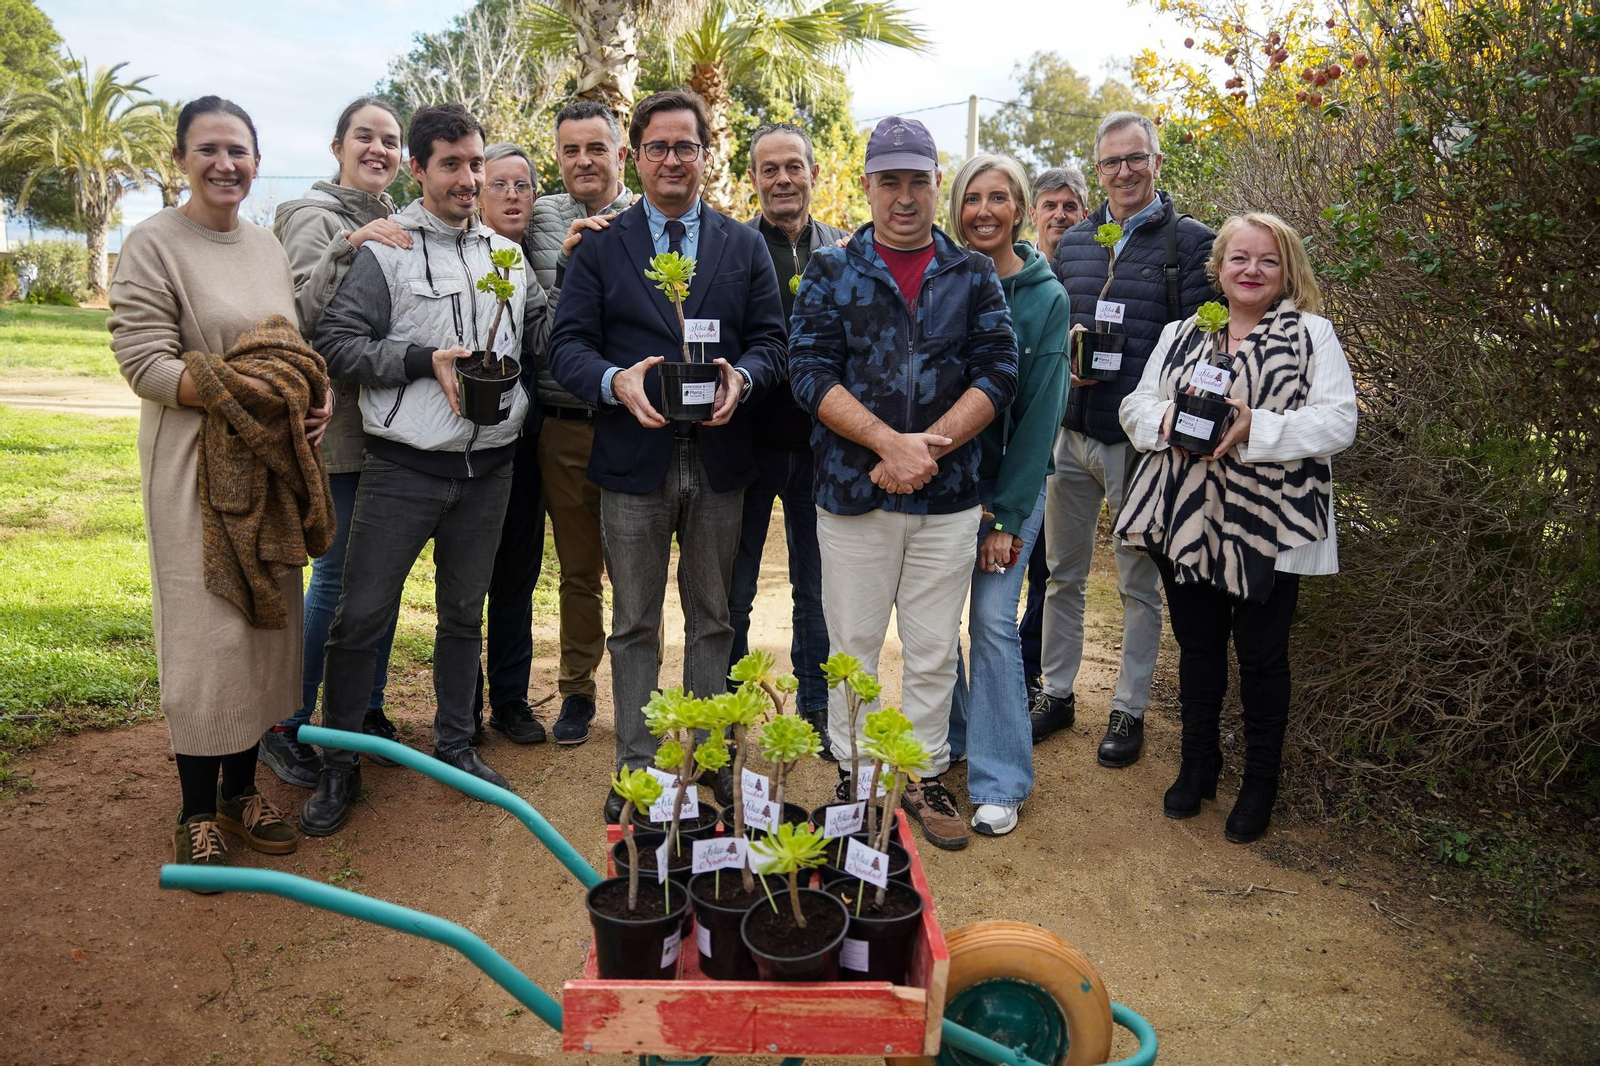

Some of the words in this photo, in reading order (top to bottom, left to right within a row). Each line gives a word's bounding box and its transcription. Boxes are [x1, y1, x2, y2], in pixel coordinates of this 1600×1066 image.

[1193, 376, 1224, 387] Navidad
[698, 843, 725, 859] Feliz
[696, 854, 741, 870] Navidad
